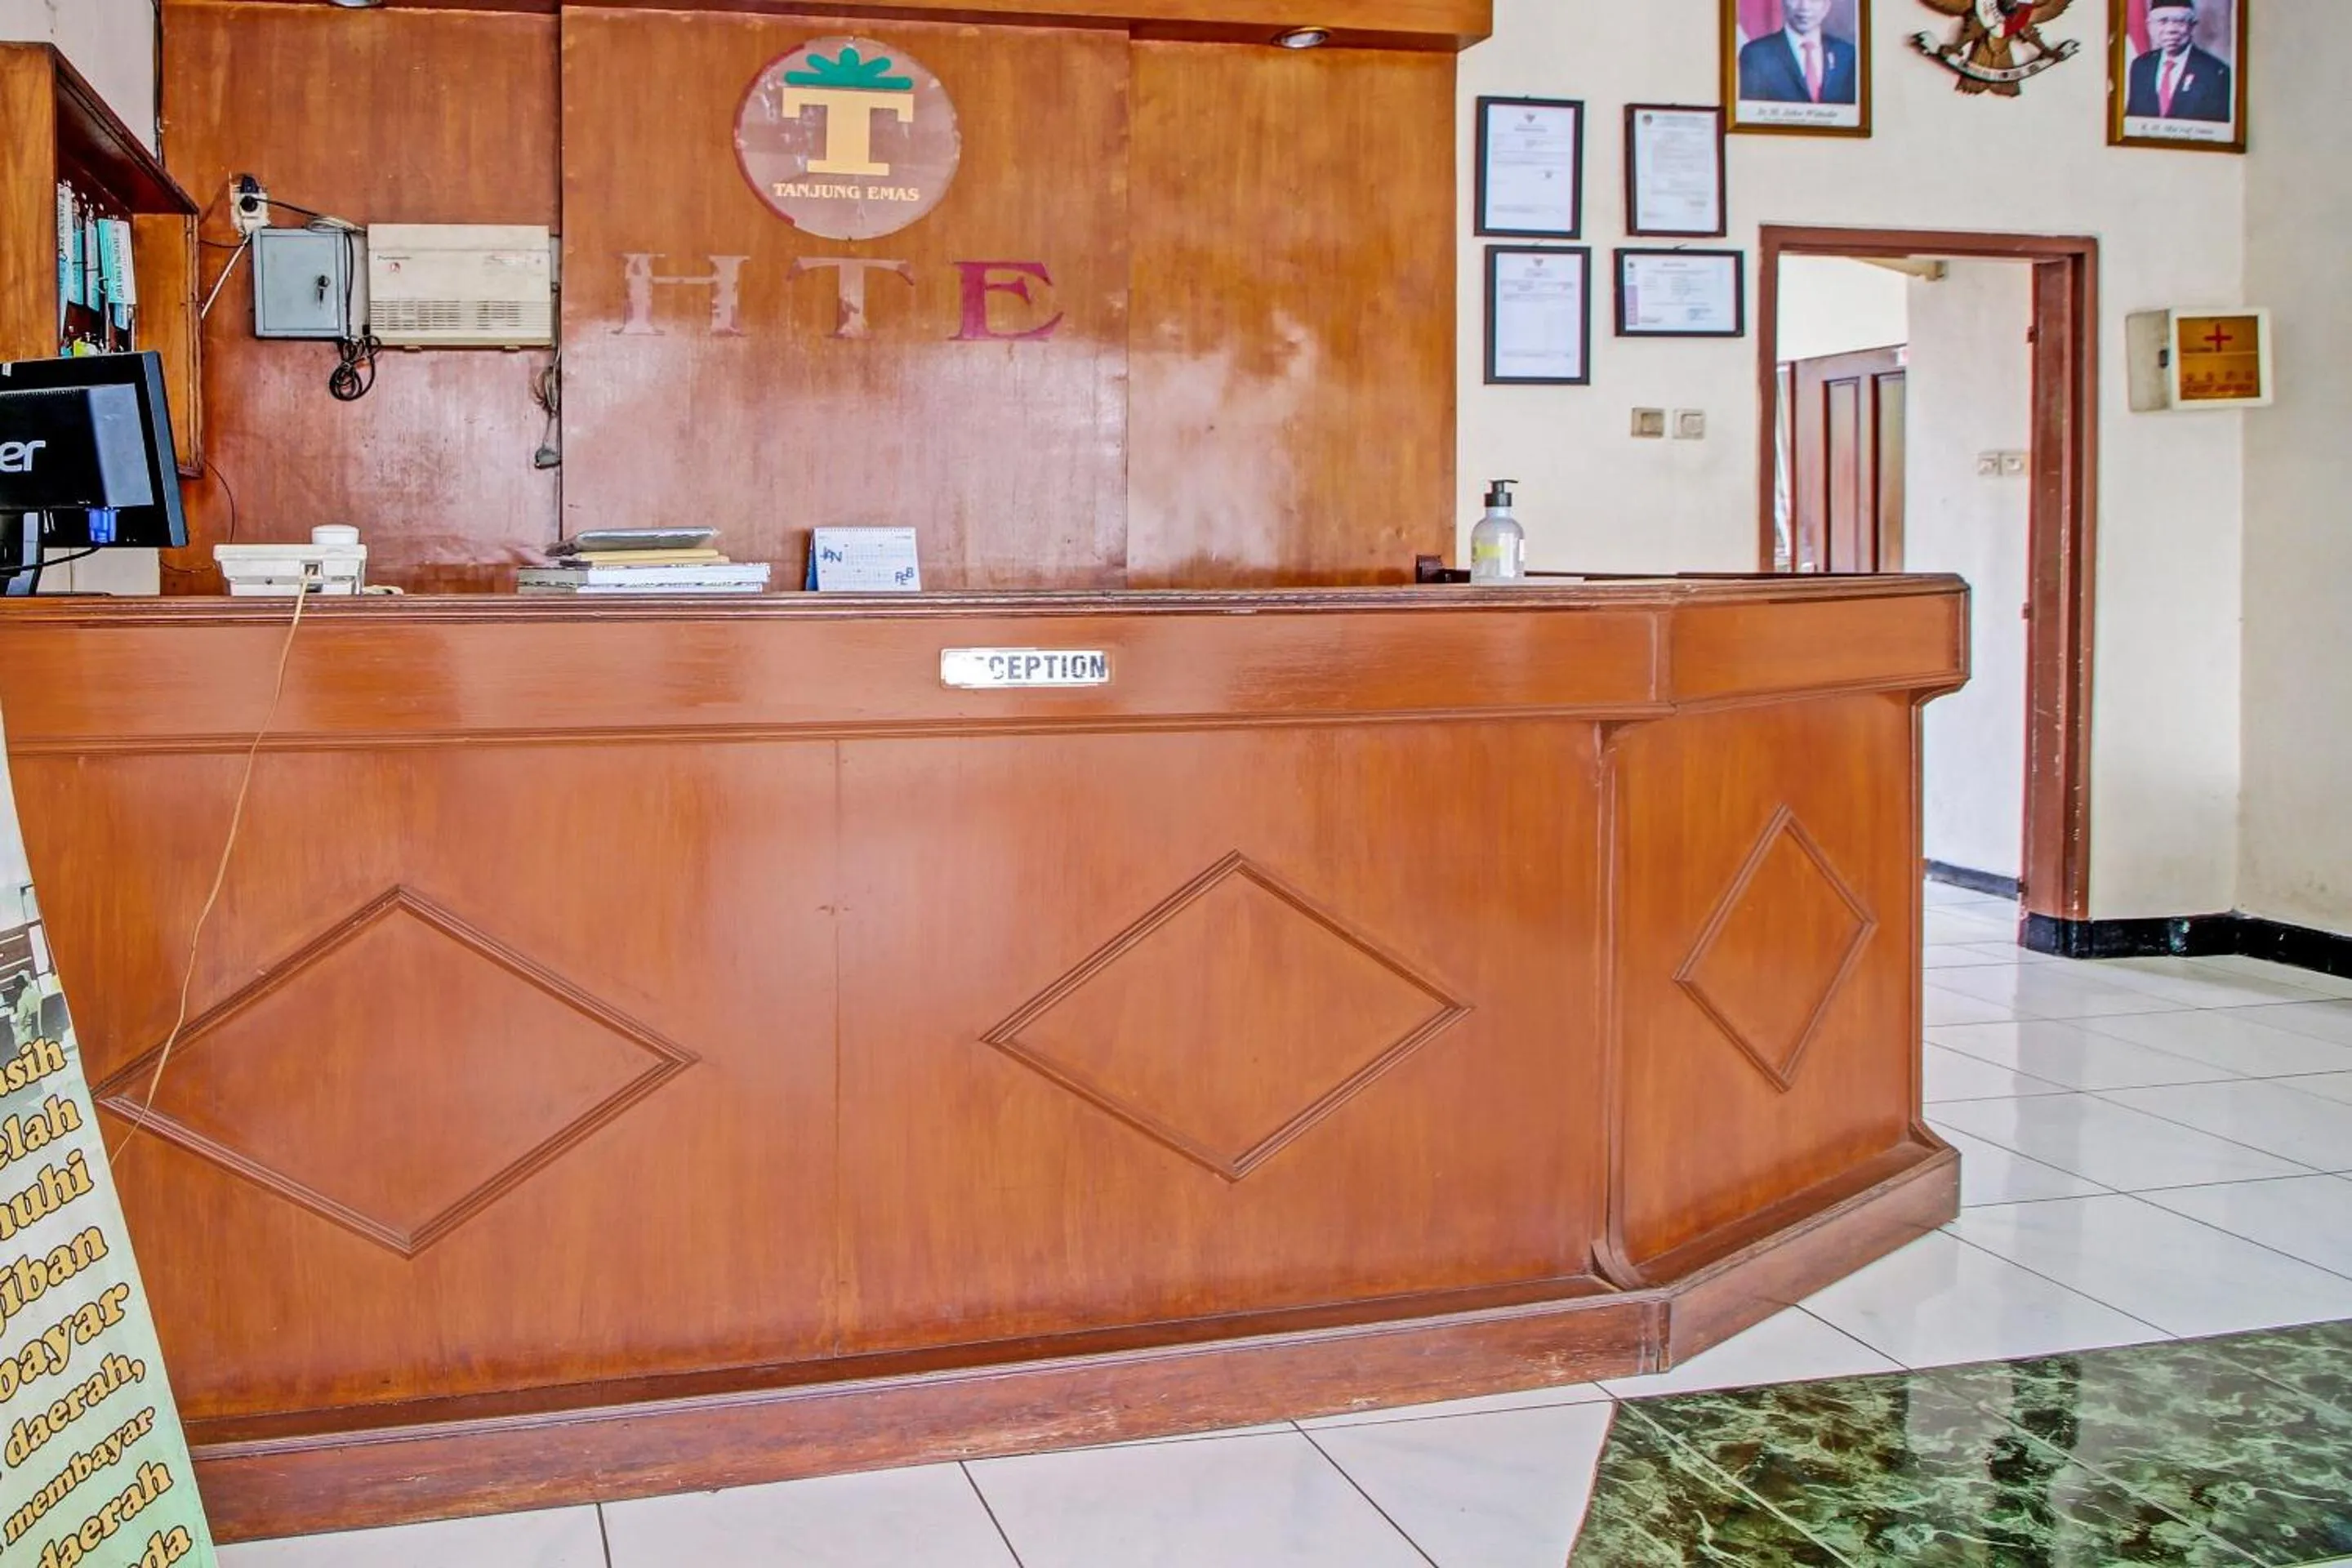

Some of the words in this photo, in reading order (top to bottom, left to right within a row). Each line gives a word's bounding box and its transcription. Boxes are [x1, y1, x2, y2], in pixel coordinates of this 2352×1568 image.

[773, 182, 861, 200] TANJUNG
[867, 186, 920, 202] EMAS
[972, 655, 1106, 679] CEPTION
[0, 1226, 109, 1338] iban
[5, 1352, 146, 1468] daerah,
[3, 1406, 156, 1546] membayar
[127, 1525, 193, 1568] da
